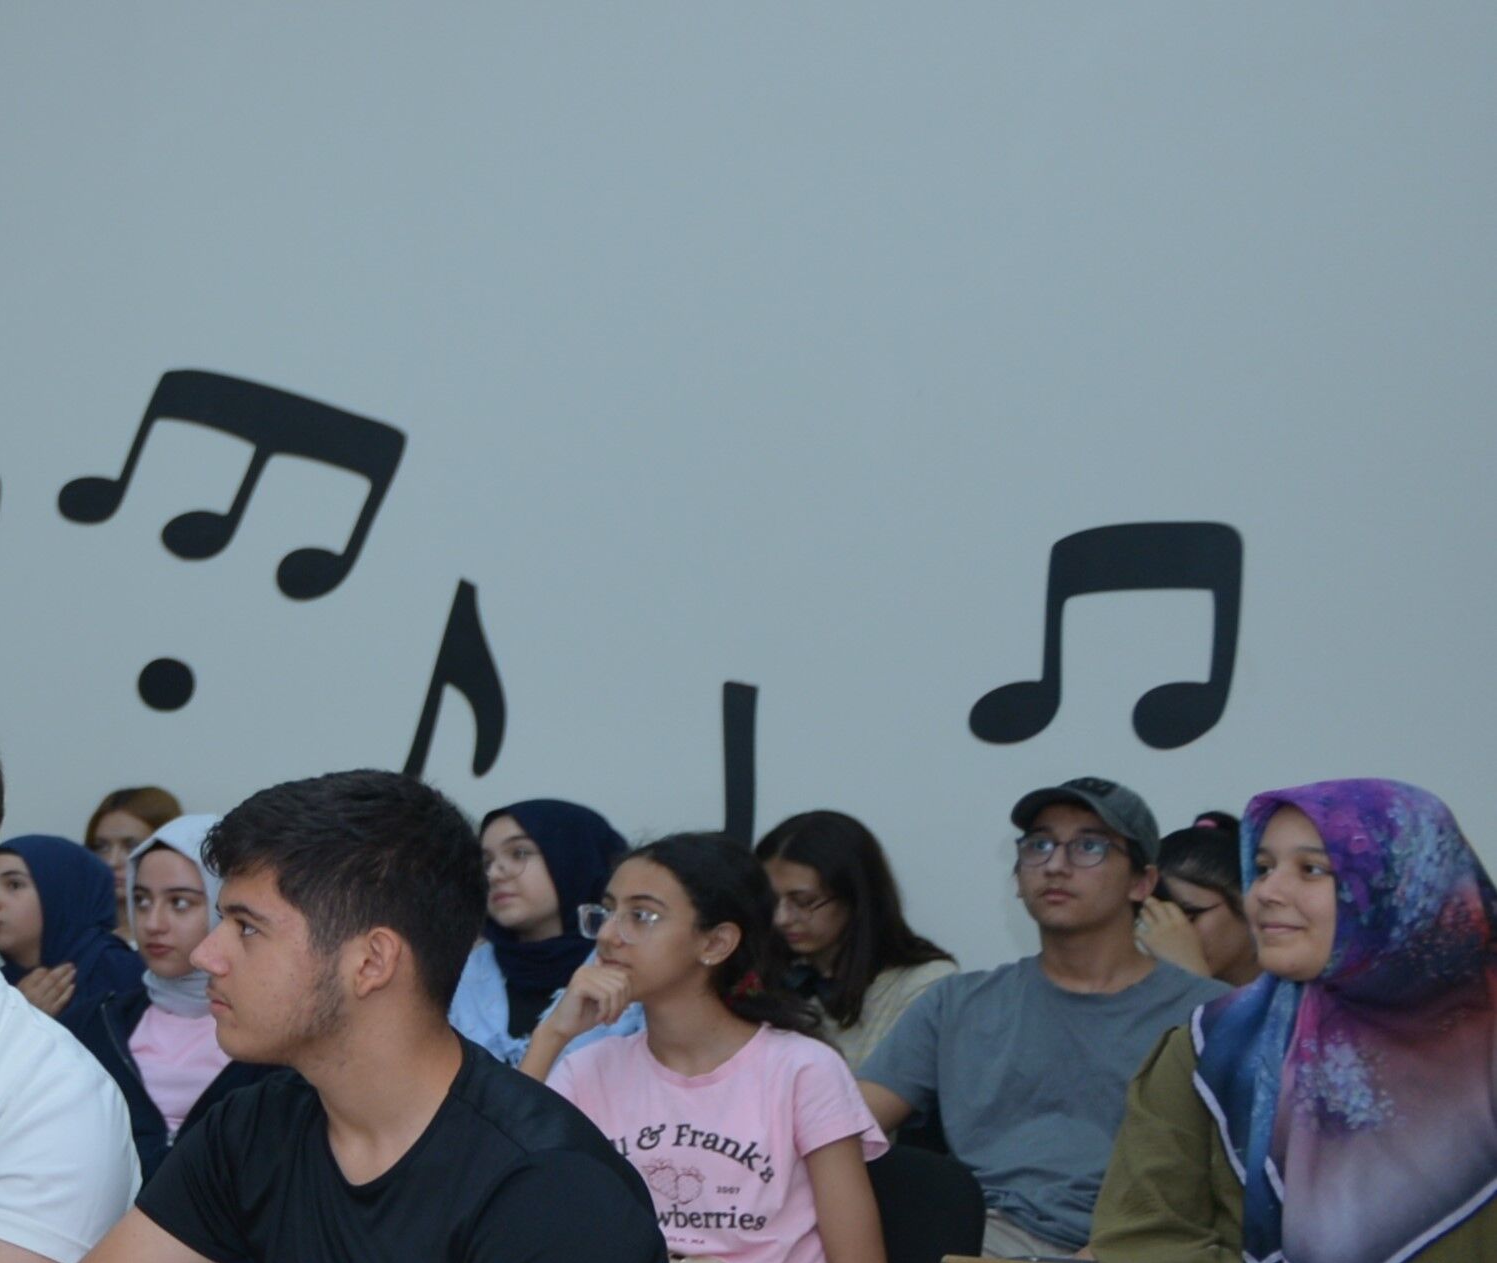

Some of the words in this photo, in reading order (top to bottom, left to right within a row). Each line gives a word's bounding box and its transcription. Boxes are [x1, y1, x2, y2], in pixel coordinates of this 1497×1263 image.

[636, 1123, 666, 1150] &
[672, 1123, 775, 1184] Frank's
[657, 1203, 768, 1231] wberries
